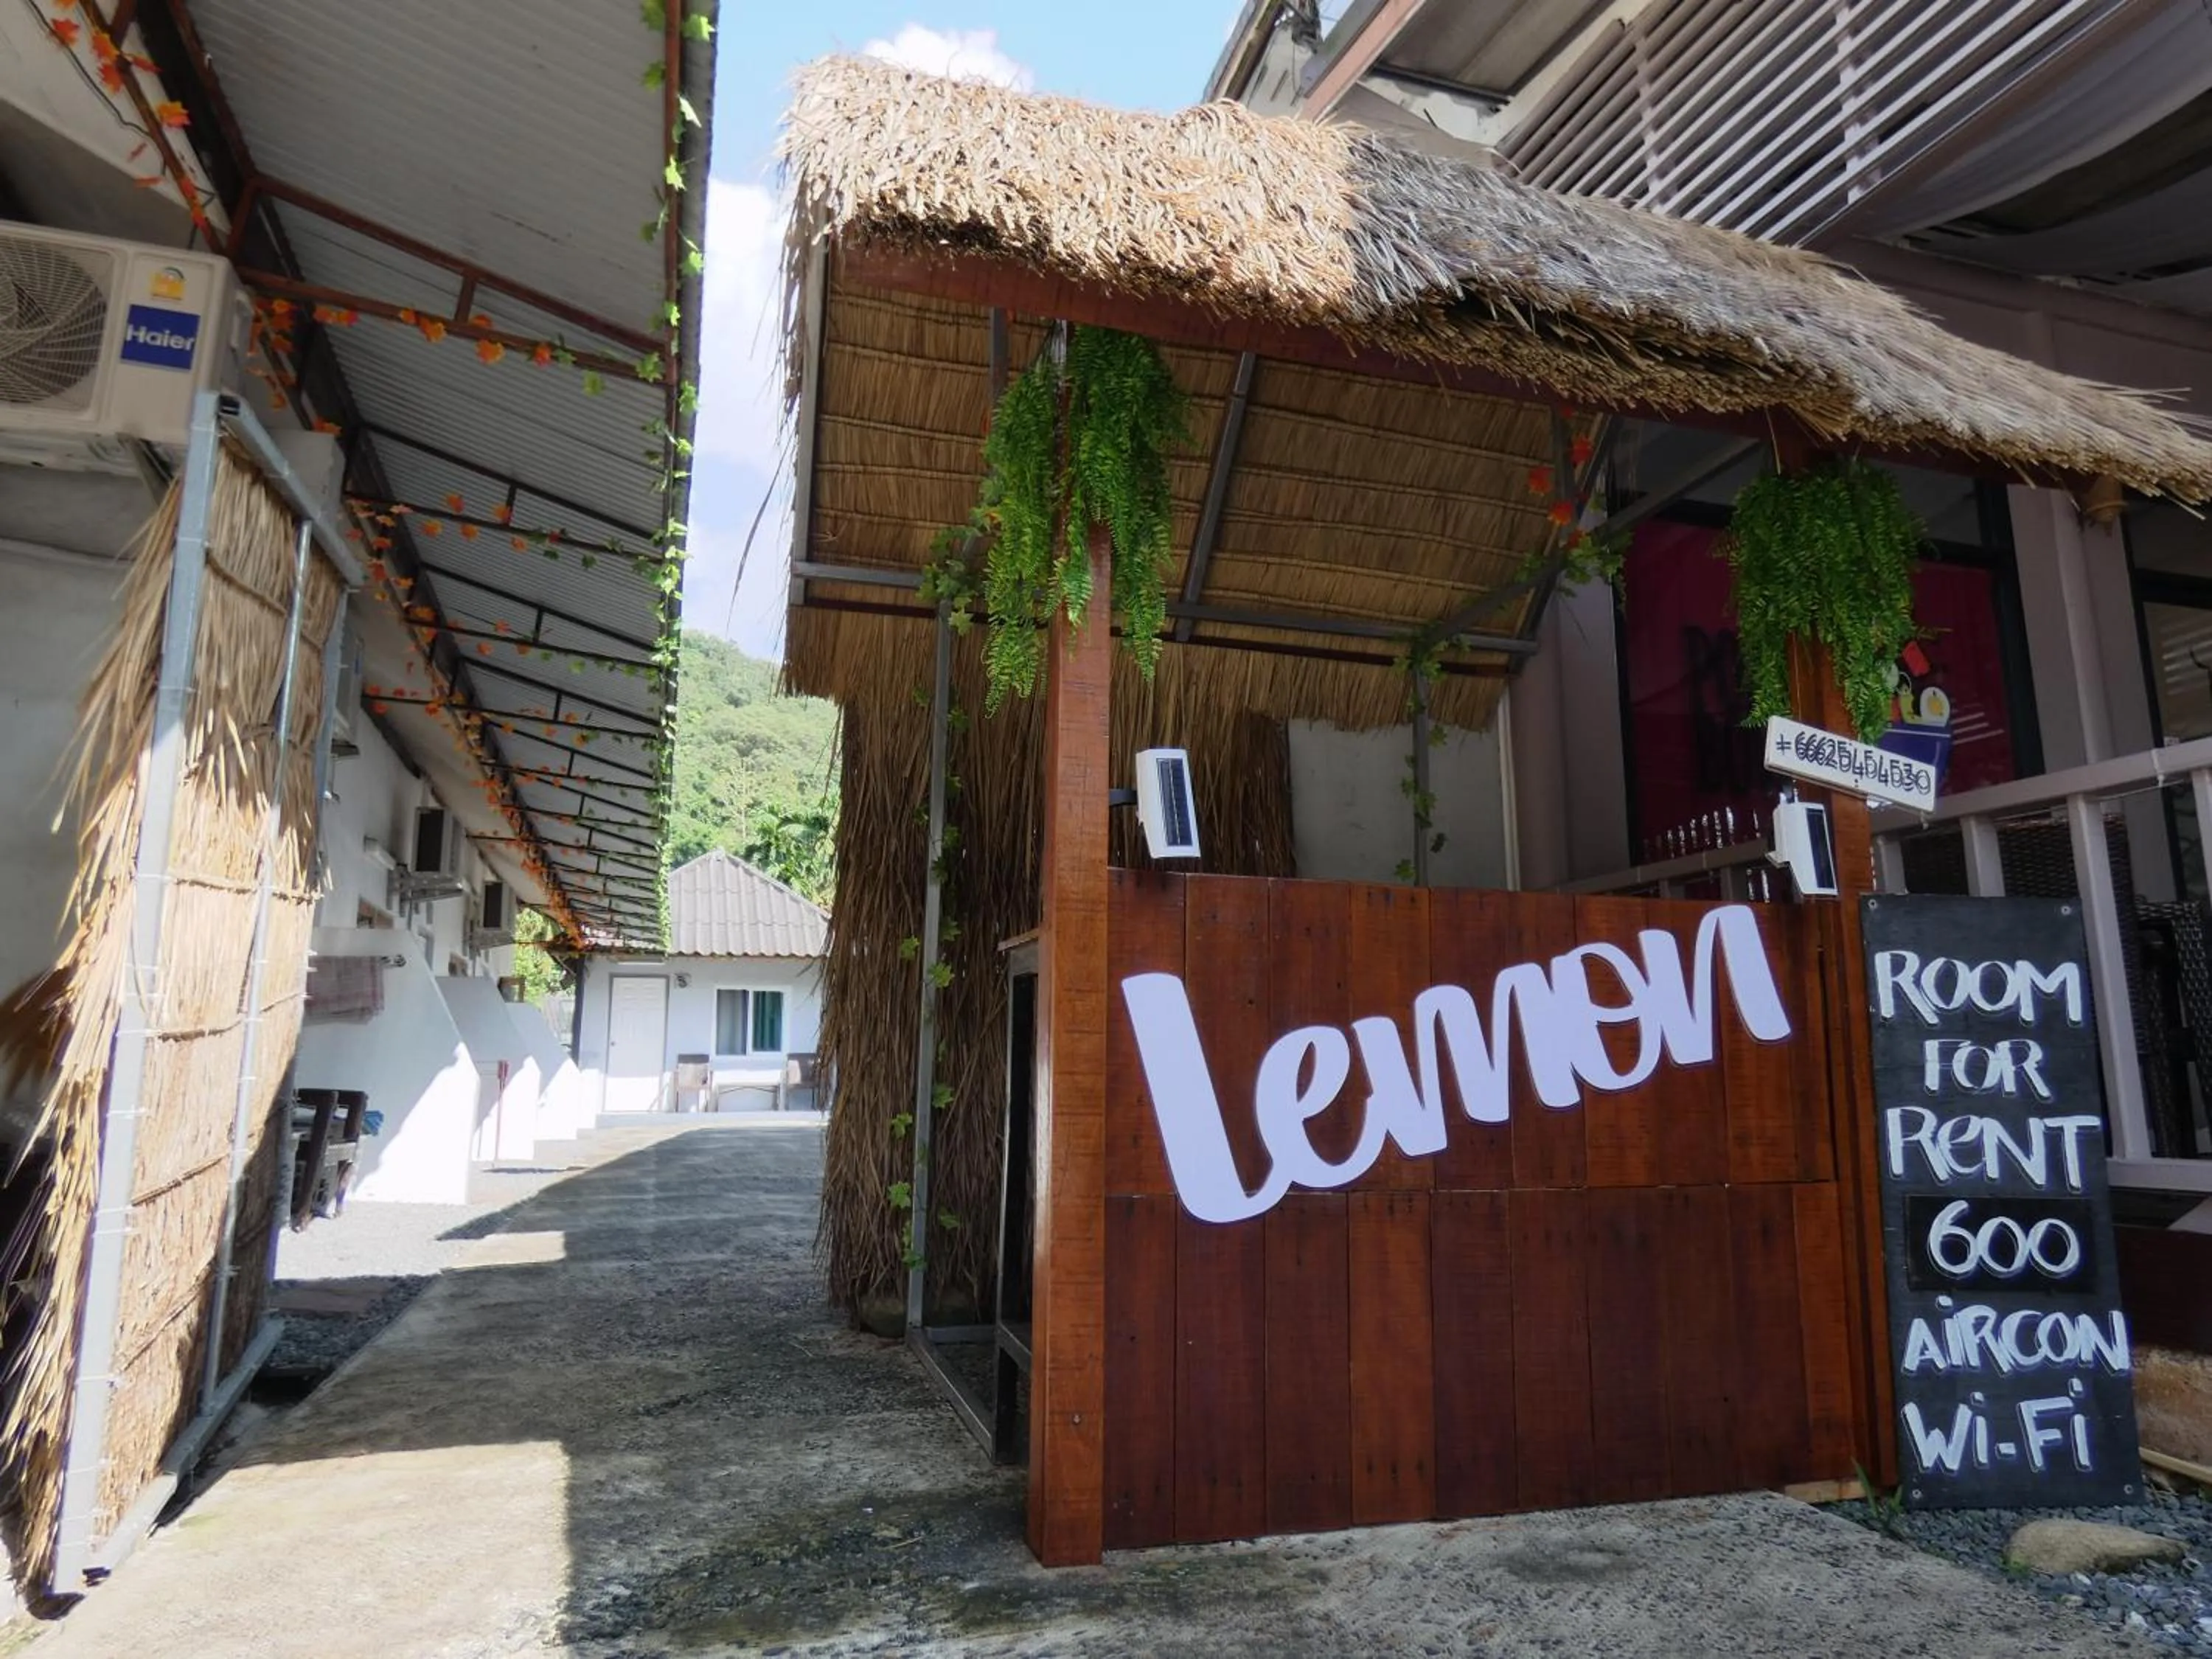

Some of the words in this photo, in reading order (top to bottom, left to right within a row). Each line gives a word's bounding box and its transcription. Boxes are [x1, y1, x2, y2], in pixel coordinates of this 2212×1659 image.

[126, 324, 195, 351] Haier
[1874, 950, 2083, 1026] ROOM
[1923, 1039, 2052, 1101] FOR
[1928, 1200, 2080, 1279] 600
[1901, 1378, 2092, 1473] Wi-Fi
